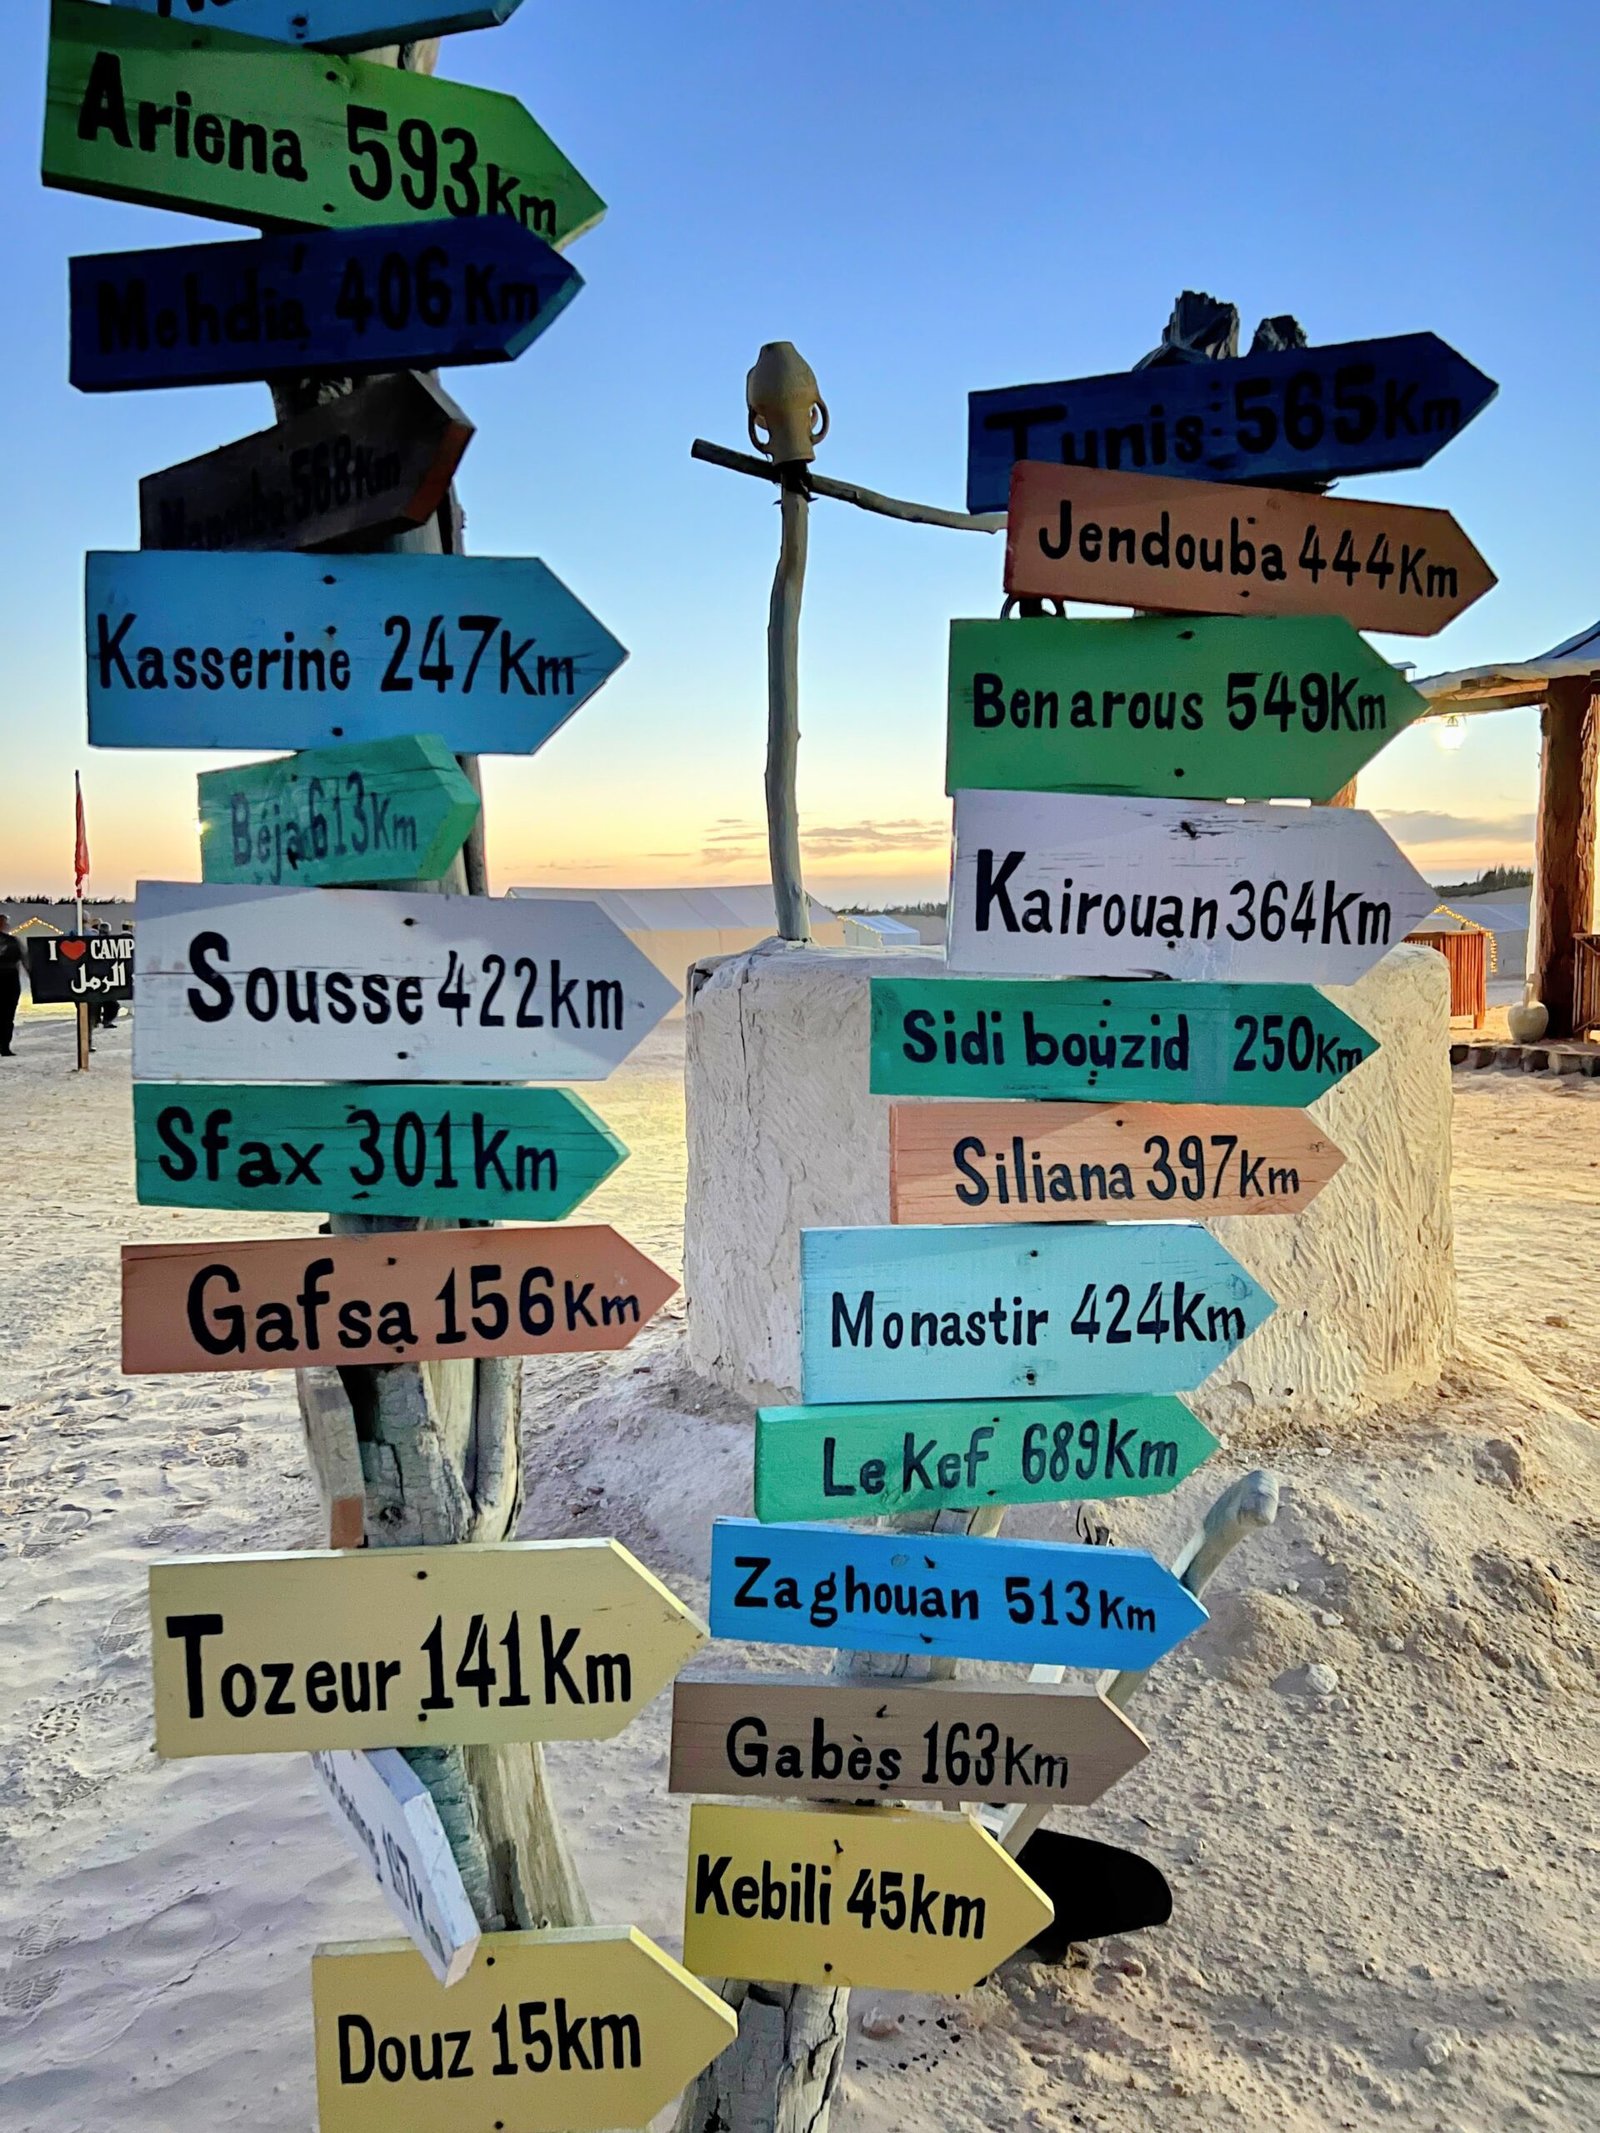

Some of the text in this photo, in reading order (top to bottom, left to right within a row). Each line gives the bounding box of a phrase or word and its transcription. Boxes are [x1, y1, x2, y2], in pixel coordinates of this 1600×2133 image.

[77, 51, 308, 182] Ariena
[984, 405, 1203, 470] Tunis
[1038, 500, 1287, 581] Jendouba
[97, 614, 350, 690] Kasserine
[975, 849, 1218, 940] Kairouan
[48, 938, 135, 961] I CAMP
[70, 961, 126, 993] الرمل
[188, 932, 423, 1023] Sousse
[903, 1009, 1005, 1066] Sidi
[158, 1106, 323, 1187] Sfax
[953, 1136, 1134, 1205] Siliana
[187, 1258, 417, 1355] Gafsa
[831, 1291, 1048, 1348] Monastir
[824, 1437, 885, 1497] Le
[903, 1427, 996, 1490] Kef
[734, 1557, 979, 1627] Zaghouan
[166, 1614, 400, 1718] Tozeur
[726, 1717, 900, 1779] Gabès
[696, 1854, 831, 1924] Kebili
[338, 2014, 473, 2084] Douz
